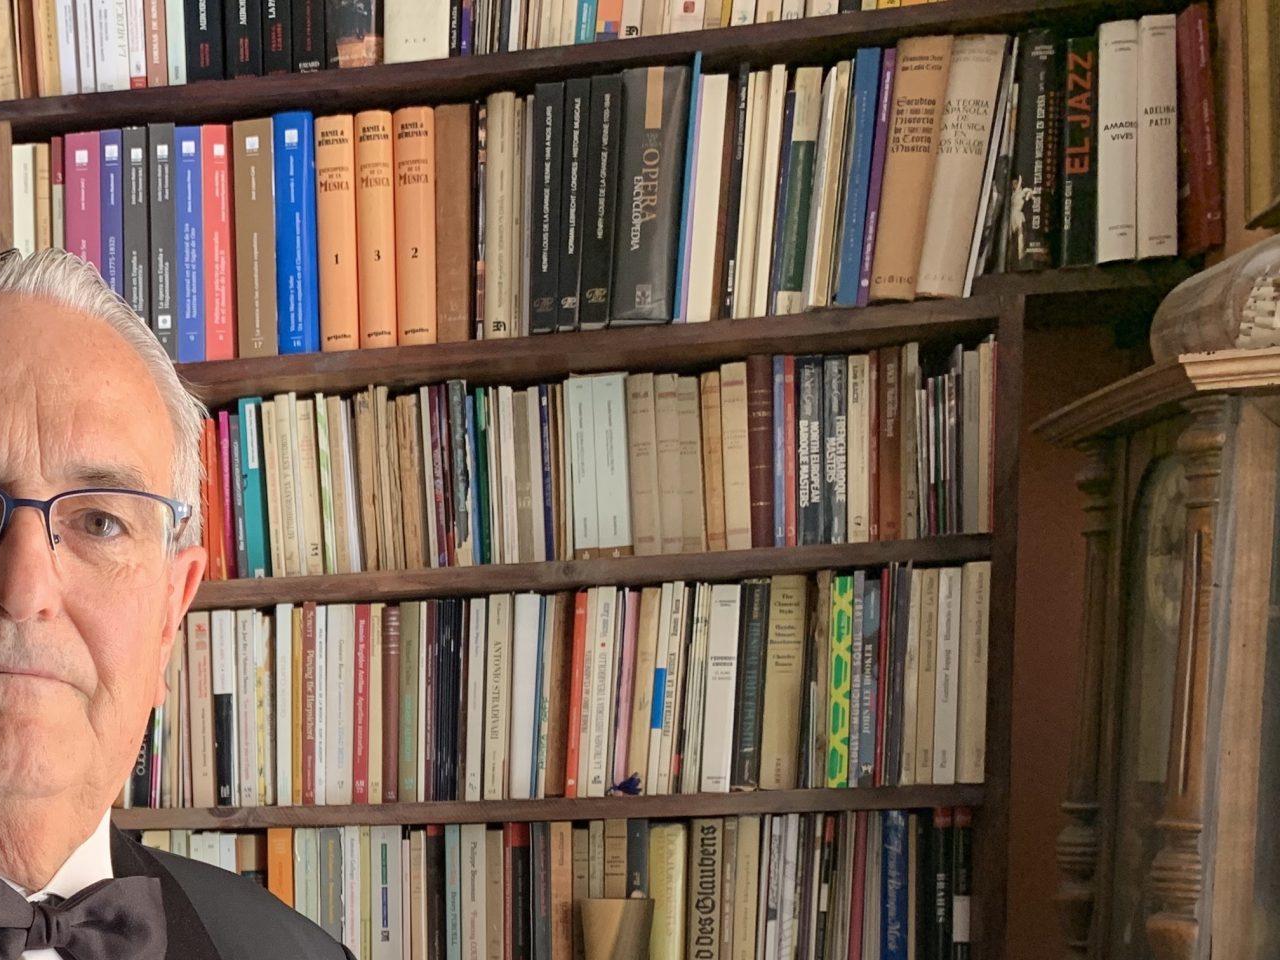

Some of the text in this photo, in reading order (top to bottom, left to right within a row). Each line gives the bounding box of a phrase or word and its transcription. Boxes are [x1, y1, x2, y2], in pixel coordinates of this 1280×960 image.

[1065, 51, 1093, 175] EL JAZZ
[1103, 121, 1138, 132] AMADEO
[1144, 104, 1176, 116] ADELINA
[1149, 117, 1172, 127] PATTI
[1110, 132, 1134, 141] VIVES
[641, 147, 660, 223] OPERA
[631, 176, 643, 251] ENCYCLOPEDIA
[334, 253, 339, 265] 1
[374, 249, 381, 261] 3
[411, 247, 419, 259] 2
[798, 420, 809, 507] BAROQUE MASTERS
[810, 421, 820, 502] NORTH EUROPEAN
[826, 437, 836, 483] MASTERS
[834, 415, 846, 502] FRENCH BAROQUE
[863, 644, 873, 685] HOOKER
[490, 640, 502, 740] ANTONIO STRADIVARI
[305, 695, 315, 739] Harpsichord
[862, 709, 871, 733] JOHN
[470, 841, 478, 868] Philippe
[695, 825, 716, 914] Glaubens
[936, 873, 945, 923] BRAHMS
